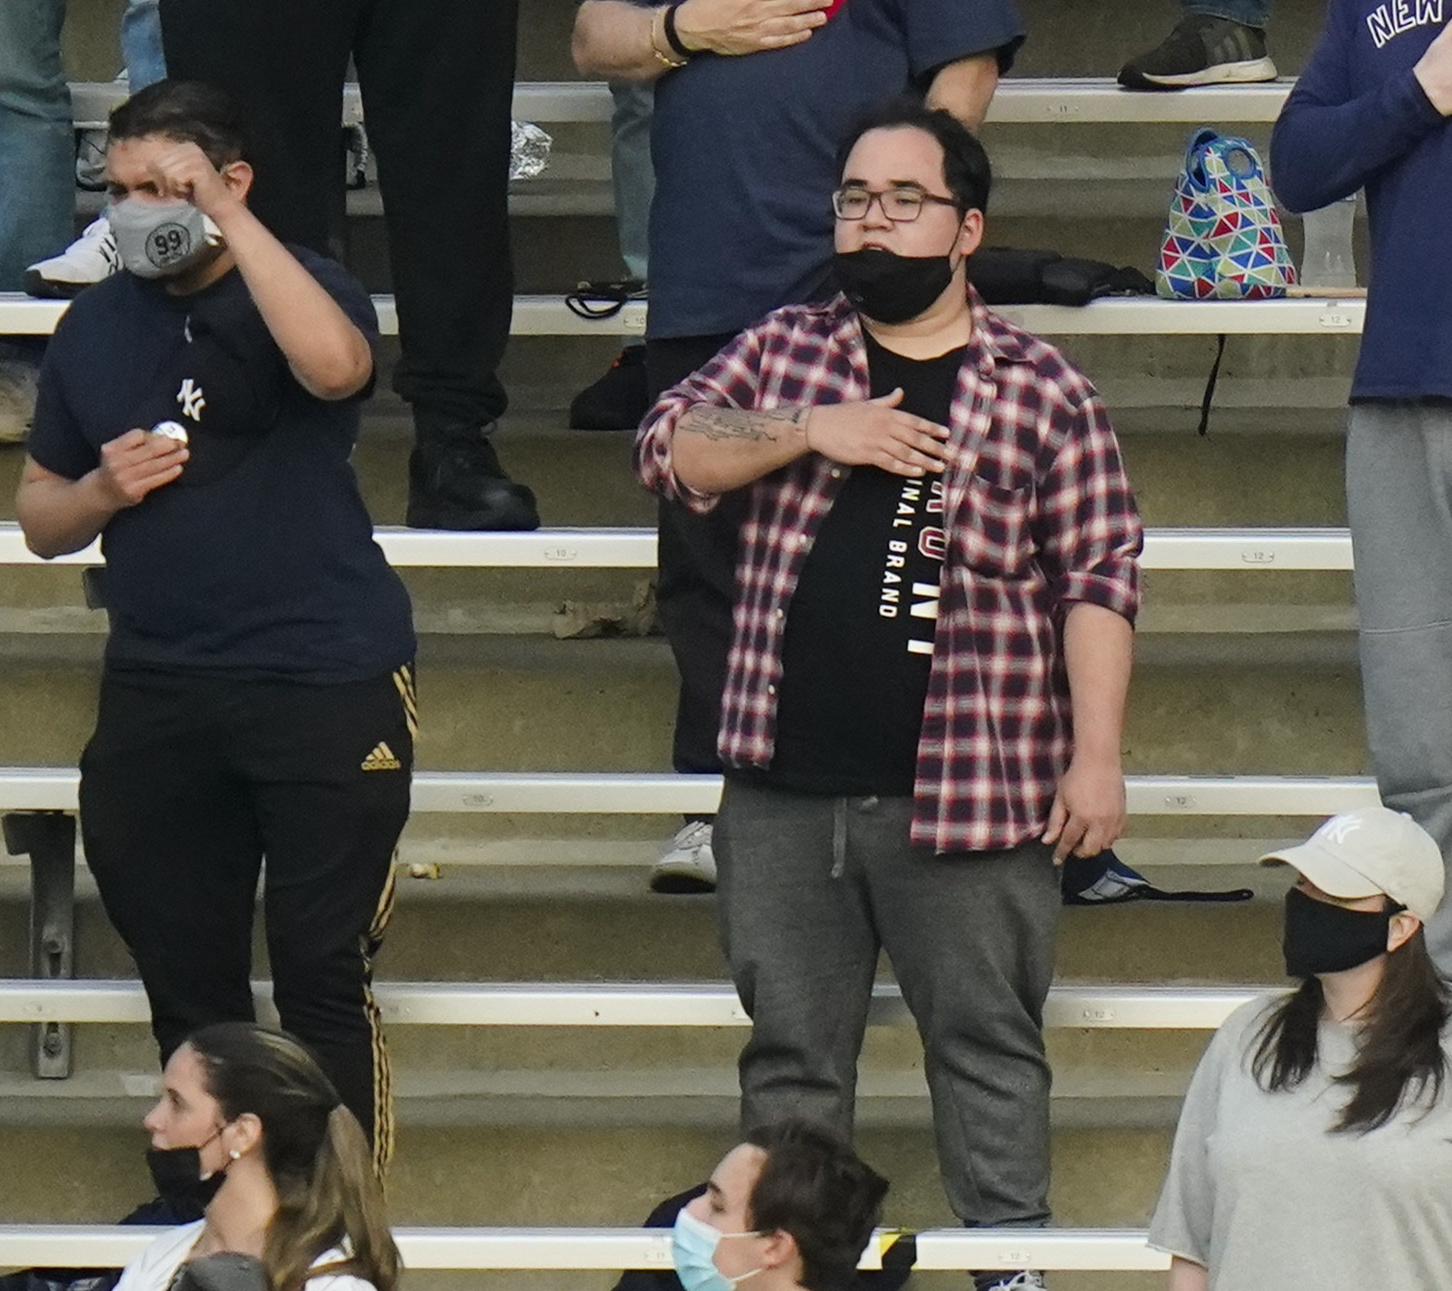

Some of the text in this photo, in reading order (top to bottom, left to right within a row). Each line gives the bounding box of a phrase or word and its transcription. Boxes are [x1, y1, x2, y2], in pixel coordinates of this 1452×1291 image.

[154, 230, 182, 256] 99
[176, 378, 206, 422] NY
[878, 540, 909, 619] BRAND
